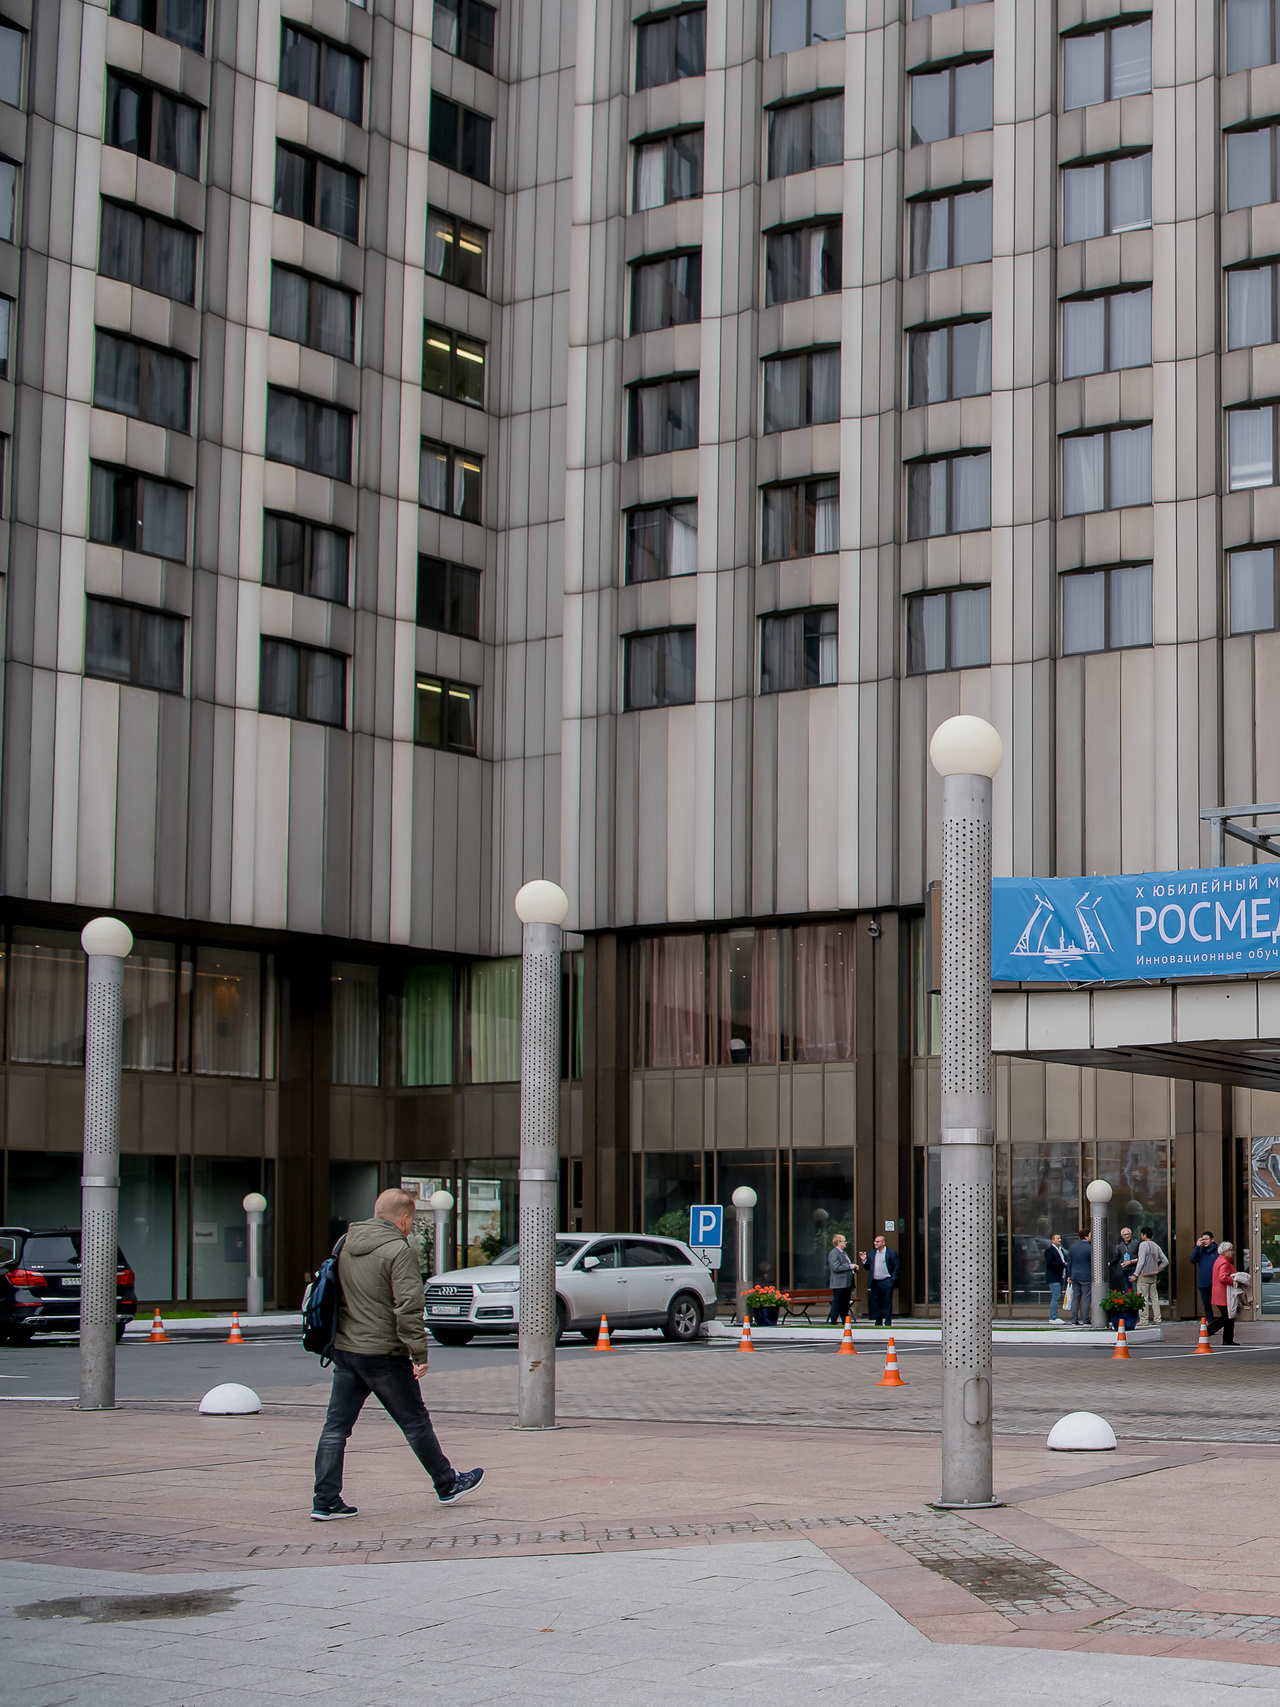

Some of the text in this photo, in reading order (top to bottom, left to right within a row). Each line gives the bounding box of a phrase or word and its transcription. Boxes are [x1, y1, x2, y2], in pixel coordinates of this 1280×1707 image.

[1152, 875, 1258, 897] ЮБИЛЕЙНЫЙ
[1136, 951, 1242, 965] Инновационные
[698, 1210, 717, 1243] P
